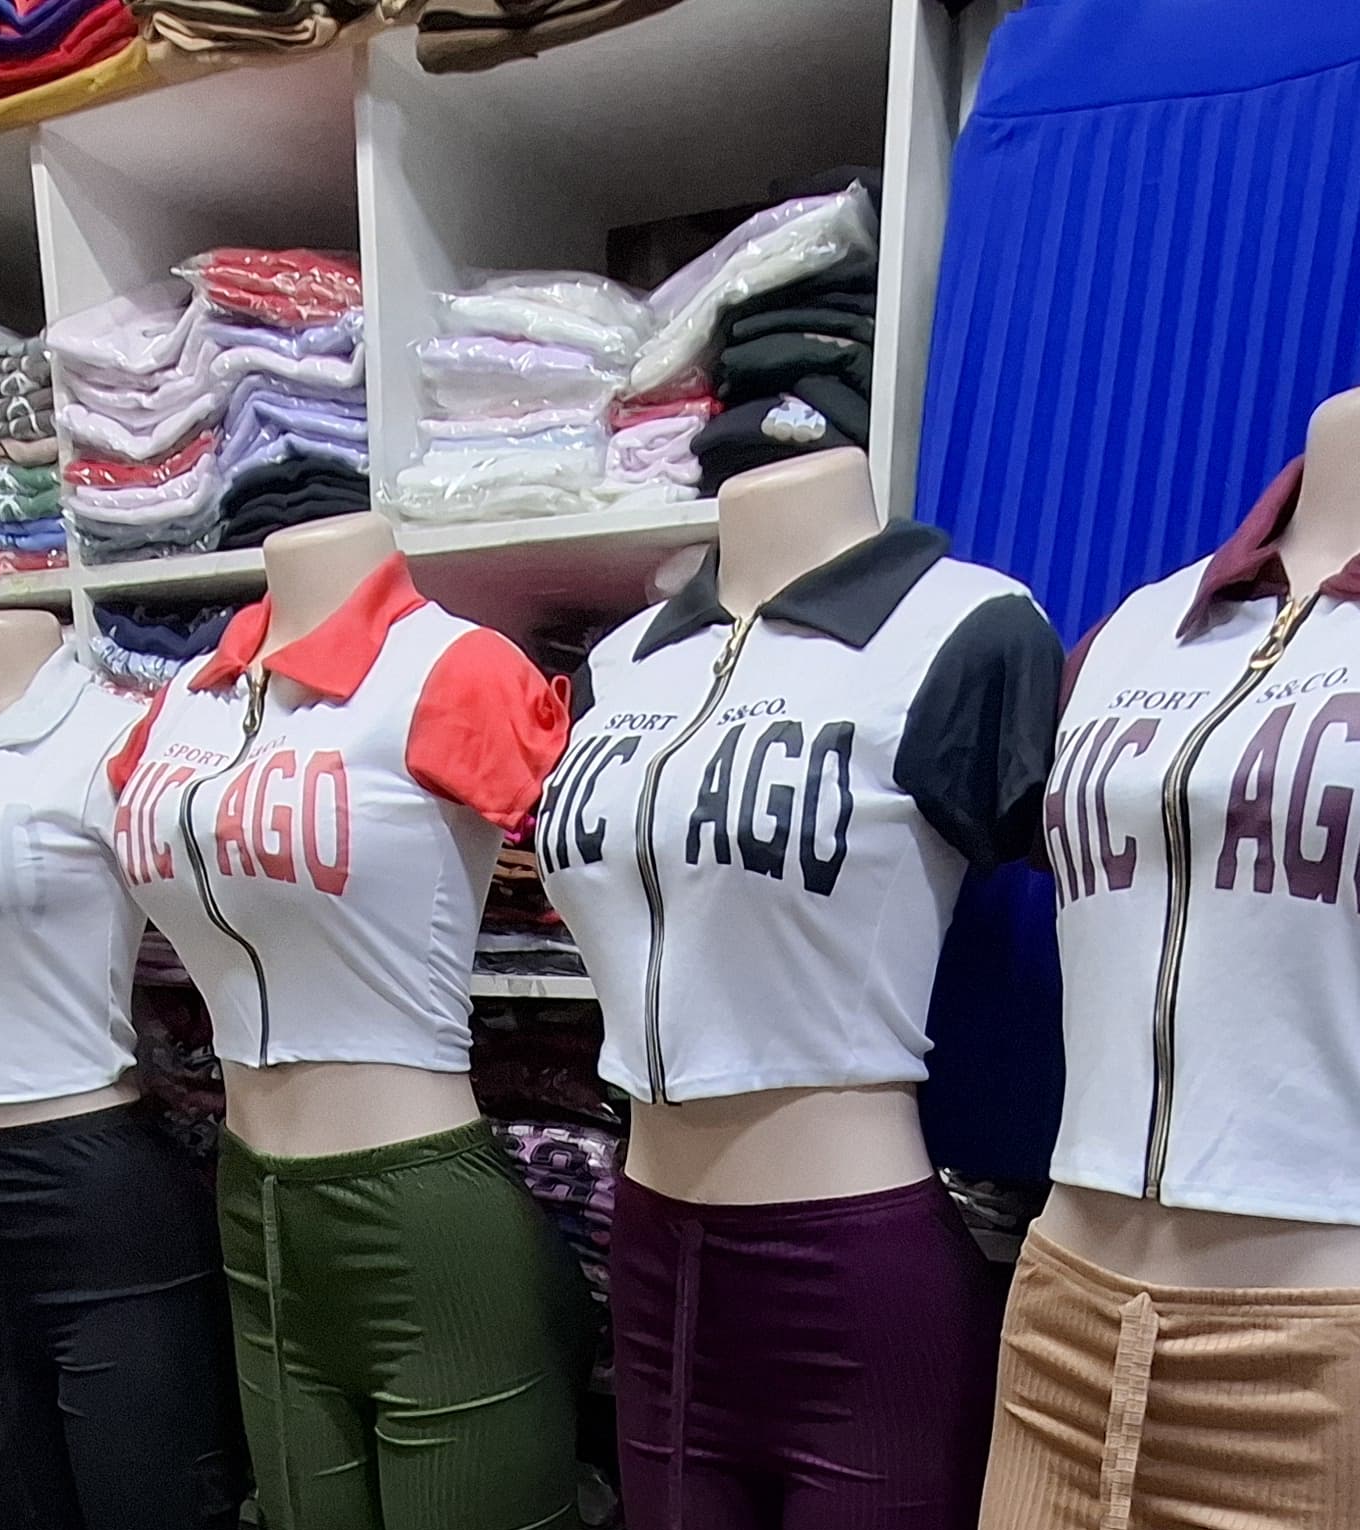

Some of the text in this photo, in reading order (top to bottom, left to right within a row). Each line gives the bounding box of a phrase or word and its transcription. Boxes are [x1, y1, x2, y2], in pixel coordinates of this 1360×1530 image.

[603, 697, 788, 731] SPORT S&CO.
[1107, 666, 1350, 711] SPORT S&CO.
[163, 742, 230, 767] SPORT
[215, 749, 351, 897] AGO
[685, 719, 856, 897] AGO
[1045, 717, 1162, 909] HIC
